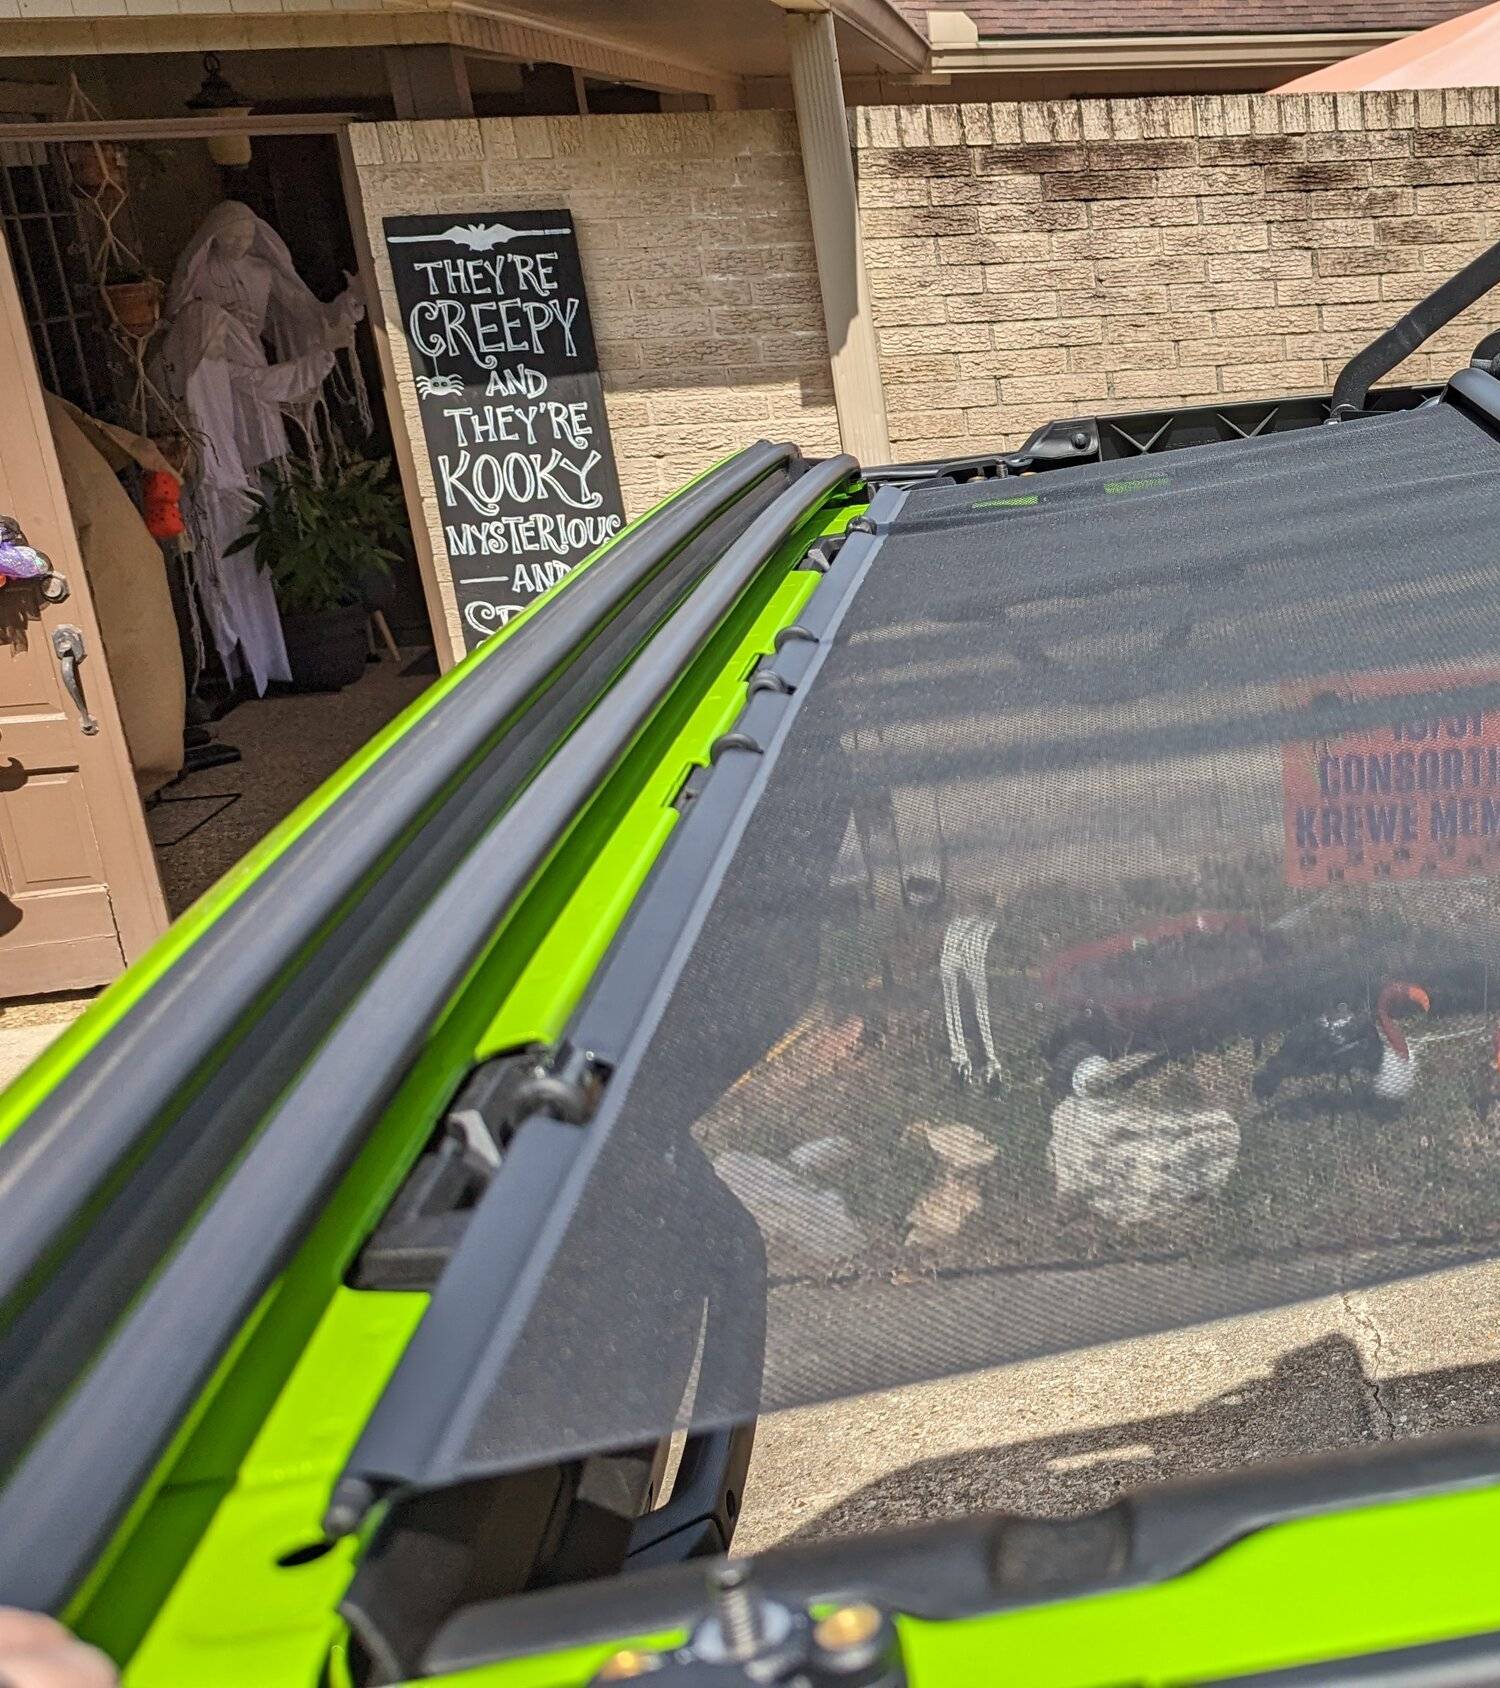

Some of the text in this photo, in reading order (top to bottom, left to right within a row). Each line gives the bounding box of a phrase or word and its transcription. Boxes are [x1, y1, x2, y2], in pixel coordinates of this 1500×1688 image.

[414, 252, 558, 297] THEY'RE
[410, 297, 579, 370] CREEPY
[484, 363, 548, 400] AND
[443, 402, 593, 450] THEY'RE
[437, 448, 604, 516] KOOKY
[445, 513, 622, 556] MYSTERIOUS
[1296, 802, 1418, 848] KREWE
